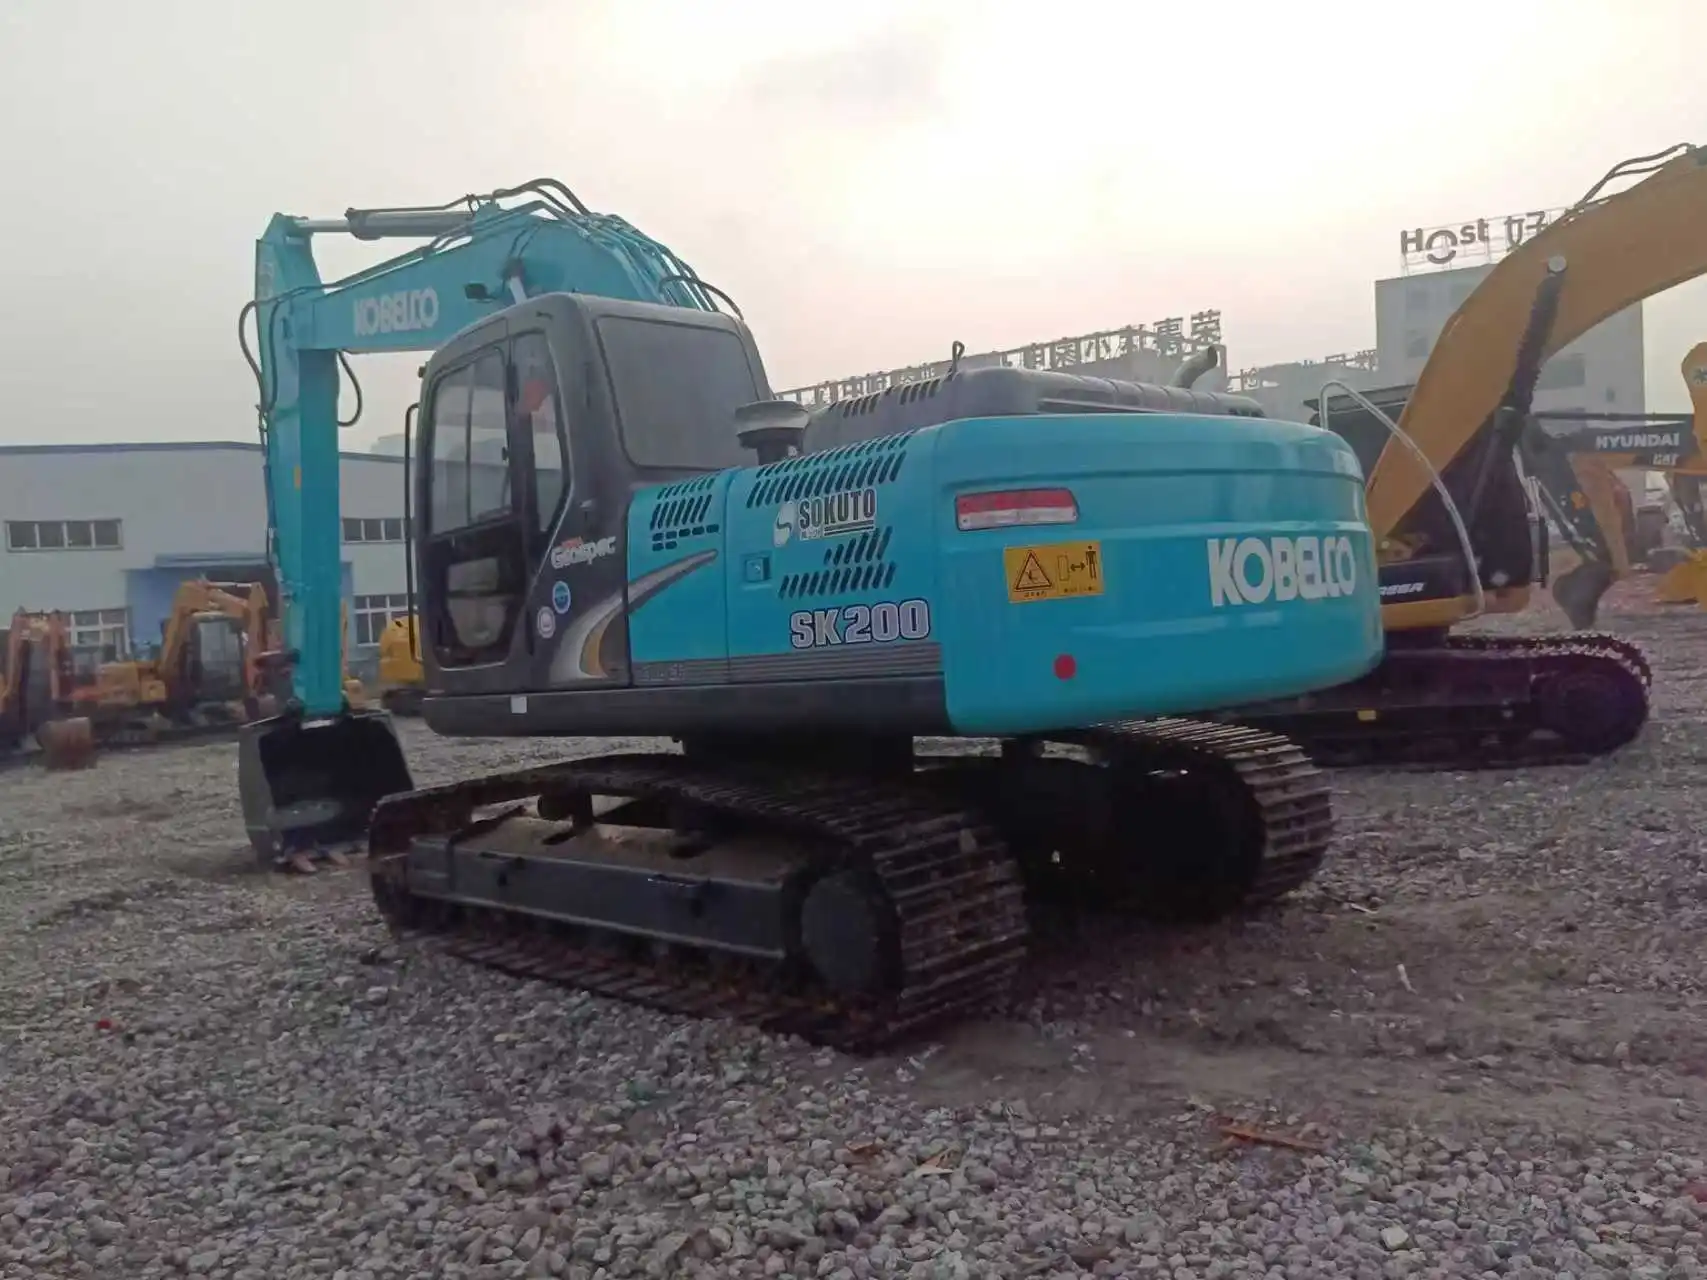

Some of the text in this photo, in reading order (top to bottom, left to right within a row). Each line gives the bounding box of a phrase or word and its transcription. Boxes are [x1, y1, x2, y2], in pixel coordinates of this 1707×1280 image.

[354, 287, 439, 337] KOBELCO
[1595, 432, 1680, 450] HYUNDAI
[799, 488, 876, 530] SOKUTO
[1207, 536, 1355, 607] KOBELCO
[790, 598, 931, 648] SK200
